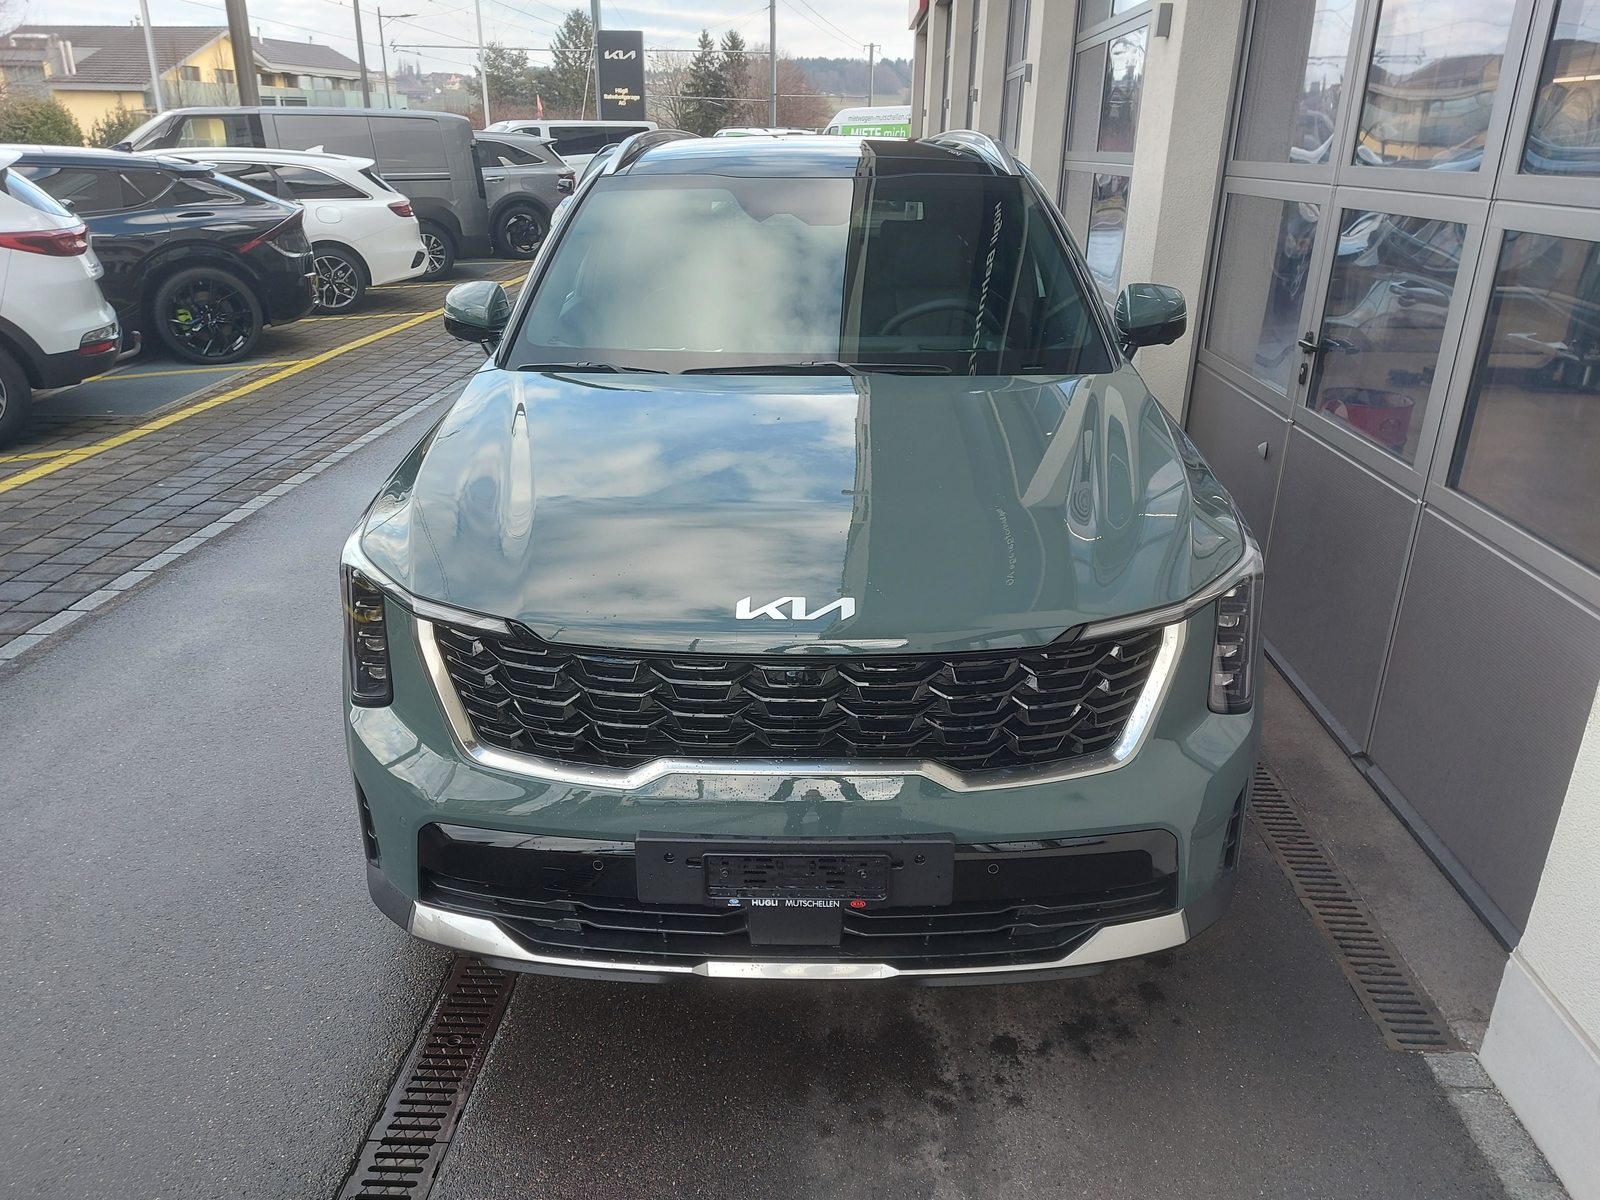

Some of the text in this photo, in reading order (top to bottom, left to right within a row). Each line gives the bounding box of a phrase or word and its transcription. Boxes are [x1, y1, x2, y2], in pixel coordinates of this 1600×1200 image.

[604, 50, 637, 60] KIA
[850, 126, 906, 137] MIETE mich
[735, 595, 856, 621] KIA
[785, 899, 840, 908] MUTSCHELLEN
